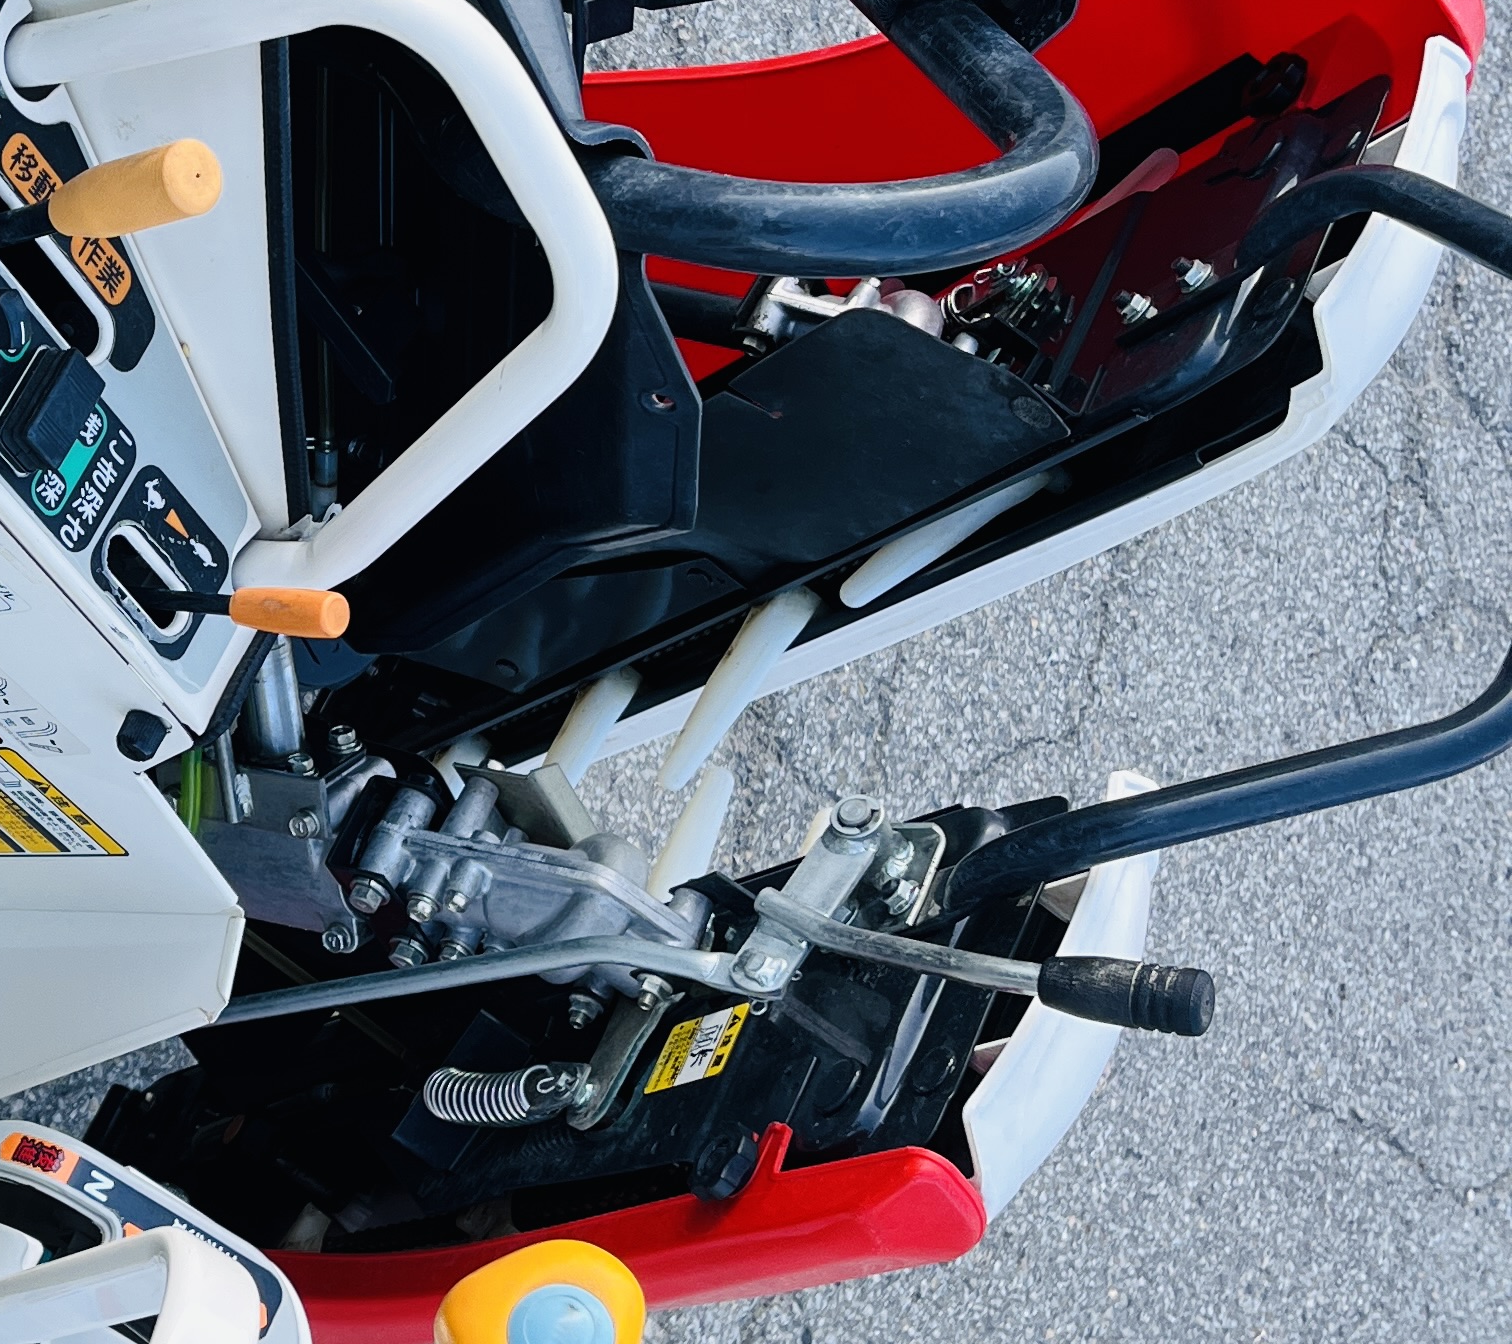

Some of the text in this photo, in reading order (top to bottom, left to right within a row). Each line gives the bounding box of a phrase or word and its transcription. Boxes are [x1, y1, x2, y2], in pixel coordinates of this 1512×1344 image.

[1, 141, 60, 205] 移動
[71, 231, 132, 299] 作業
[35, 468, 67, 508] 深
[59, 428, 133, 549] こき深さ
[83, 1169, 115, 1202] N
